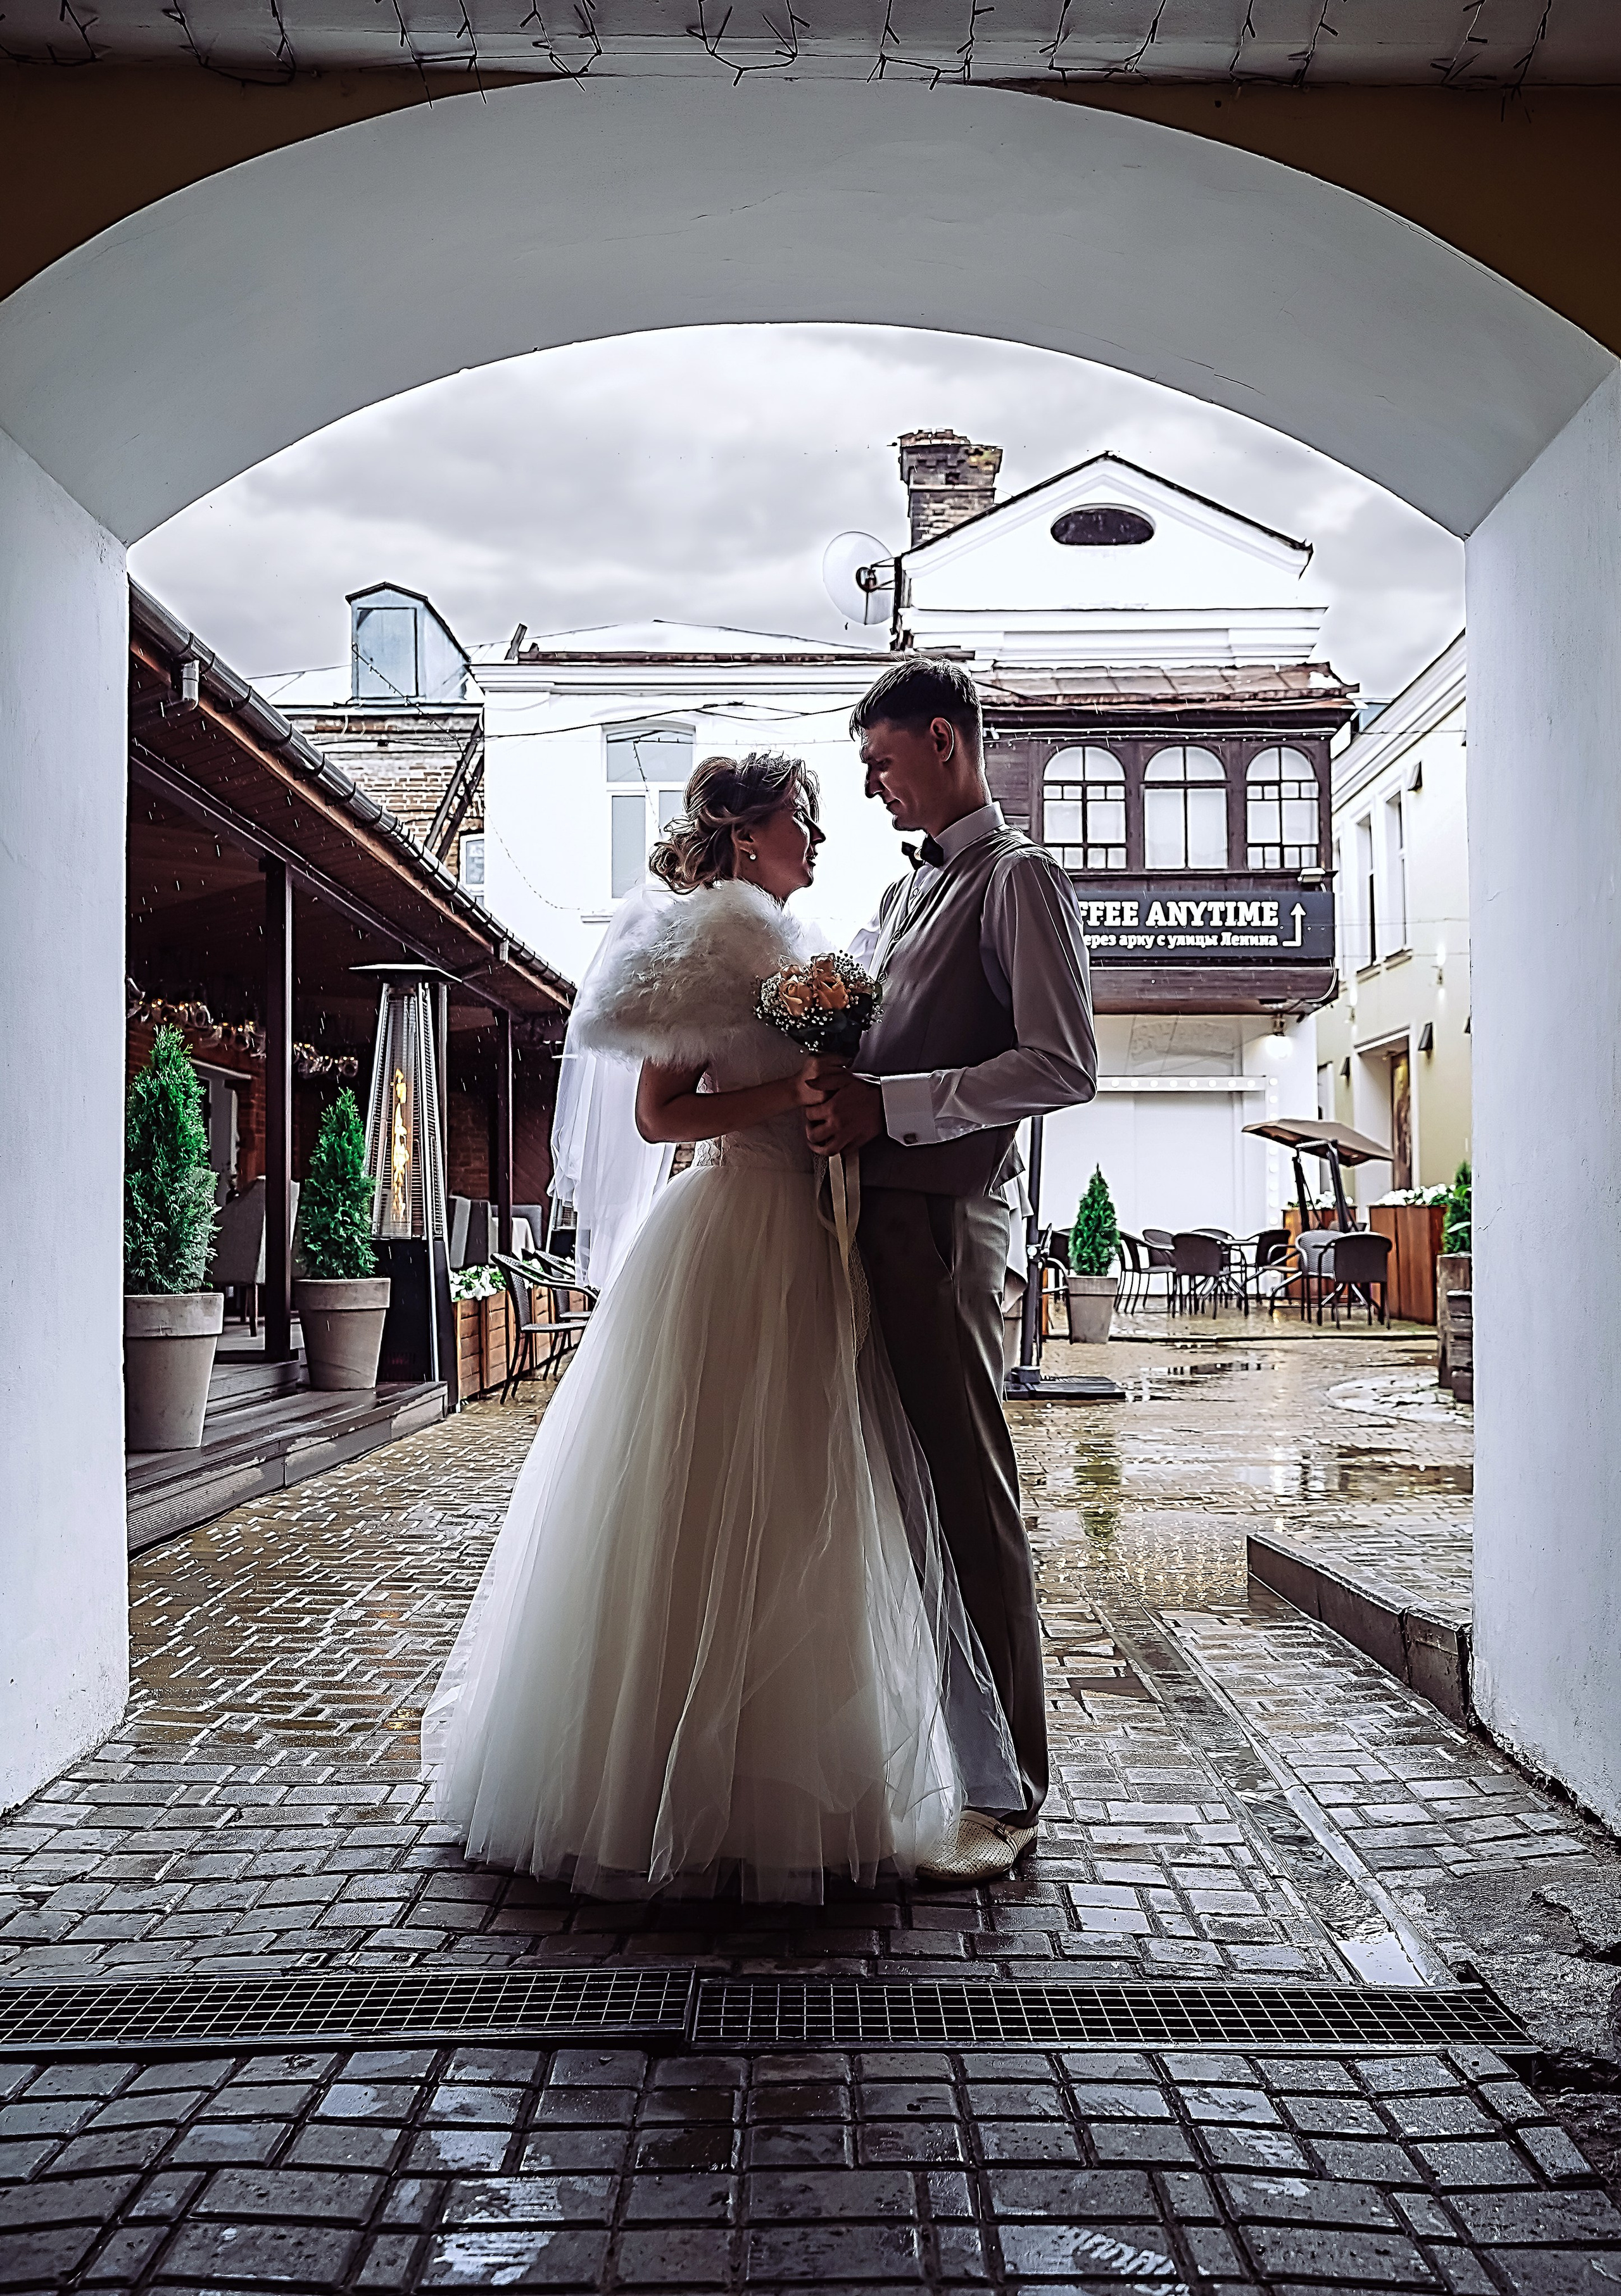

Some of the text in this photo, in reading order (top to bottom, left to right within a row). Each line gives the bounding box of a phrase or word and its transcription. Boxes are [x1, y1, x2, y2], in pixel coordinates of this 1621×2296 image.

[1145, 901, 1279, 927] ANYTIME
[1118, 934, 1156, 950] арку
[1156, 934, 1166, 946] с
[1167, 934, 1219, 950] улицы
[1220, 931, 1279, 946] Ленина
